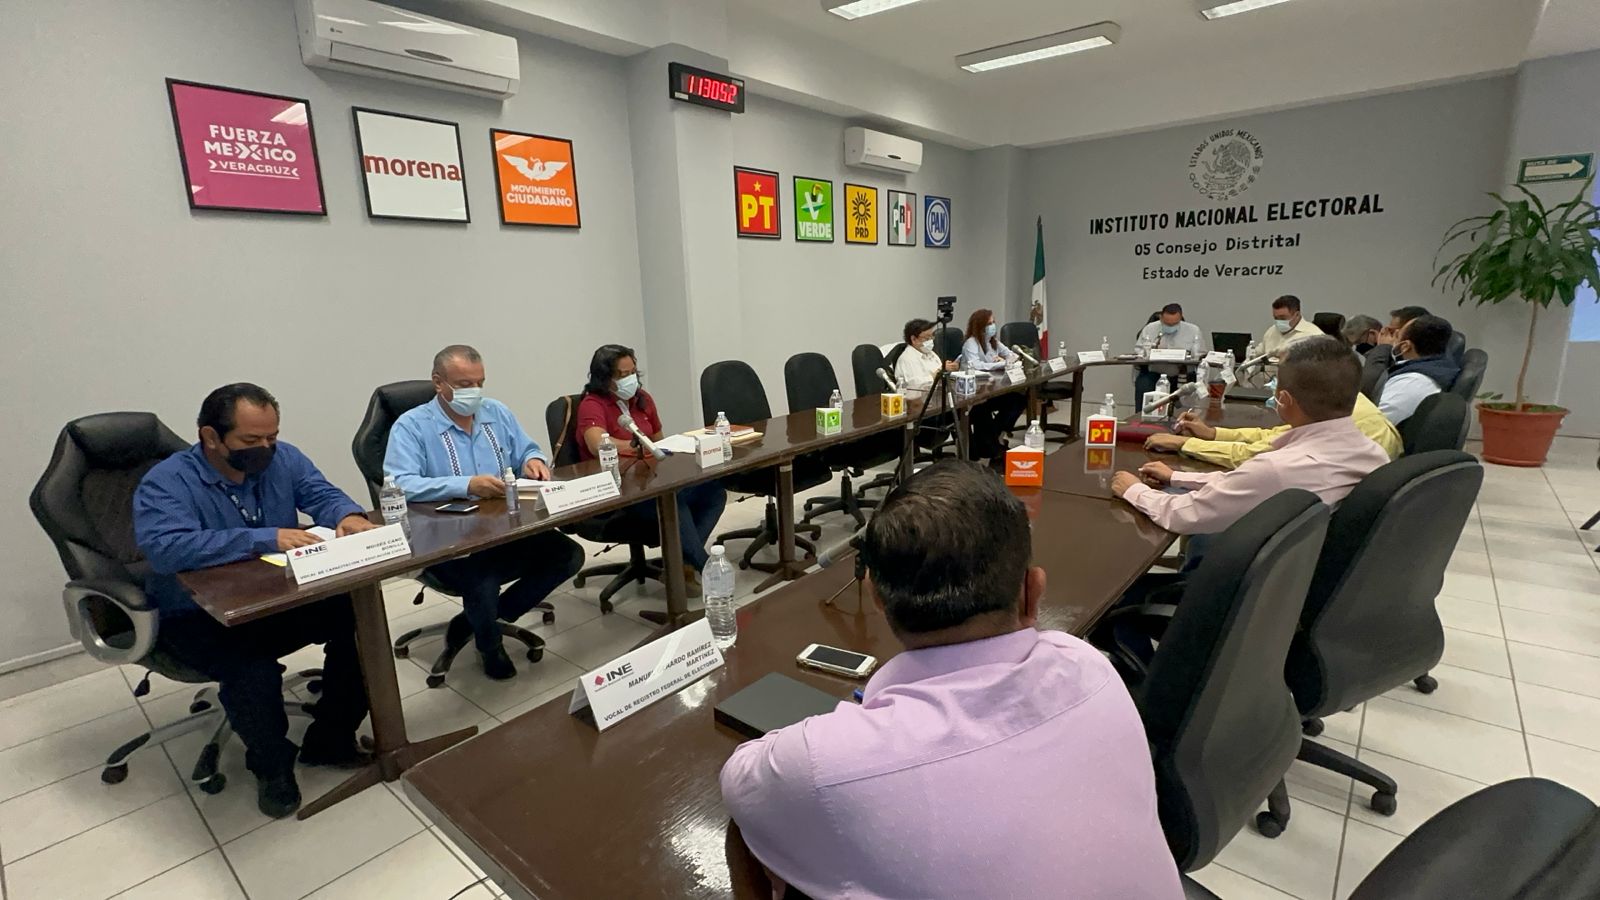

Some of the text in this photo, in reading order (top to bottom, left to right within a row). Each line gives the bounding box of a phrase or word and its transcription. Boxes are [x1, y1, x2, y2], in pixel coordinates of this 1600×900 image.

[688, 75, 737, 104] 113052
[209, 124, 287, 146] FUERZA
[1209, 129, 1234, 142] UNIDOS
[203, 140, 297, 162] MEXICO
[219, 160, 291, 175] VERACRUZ
[364, 154, 462, 181] morena
[506, 192, 573, 207] CIUDADANO
[510, 184, 567, 196] MOVIMIENTO
[741, 193, 774, 229] PT
[893, 205, 911, 229] PRI
[1089, 194, 1384, 235] INSTITUTO NACIONAL ELECTORAL
[798, 221, 832, 238] VERDE
[854, 226, 869, 238] PRD
[931, 212, 946, 233] PAN
[1134, 233, 1300, 256] 05 Consejo Distrital
[1143, 264, 1284, 280] Estado de Veracruz
[1090, 428, 1112, 442] PT
[305, 545, 328, 555] INE
[606, 662, 633, 682] INE
[604, 658, 718, 722] VOCAL DE REGISTRO FEDERAL DE ELECTORES
